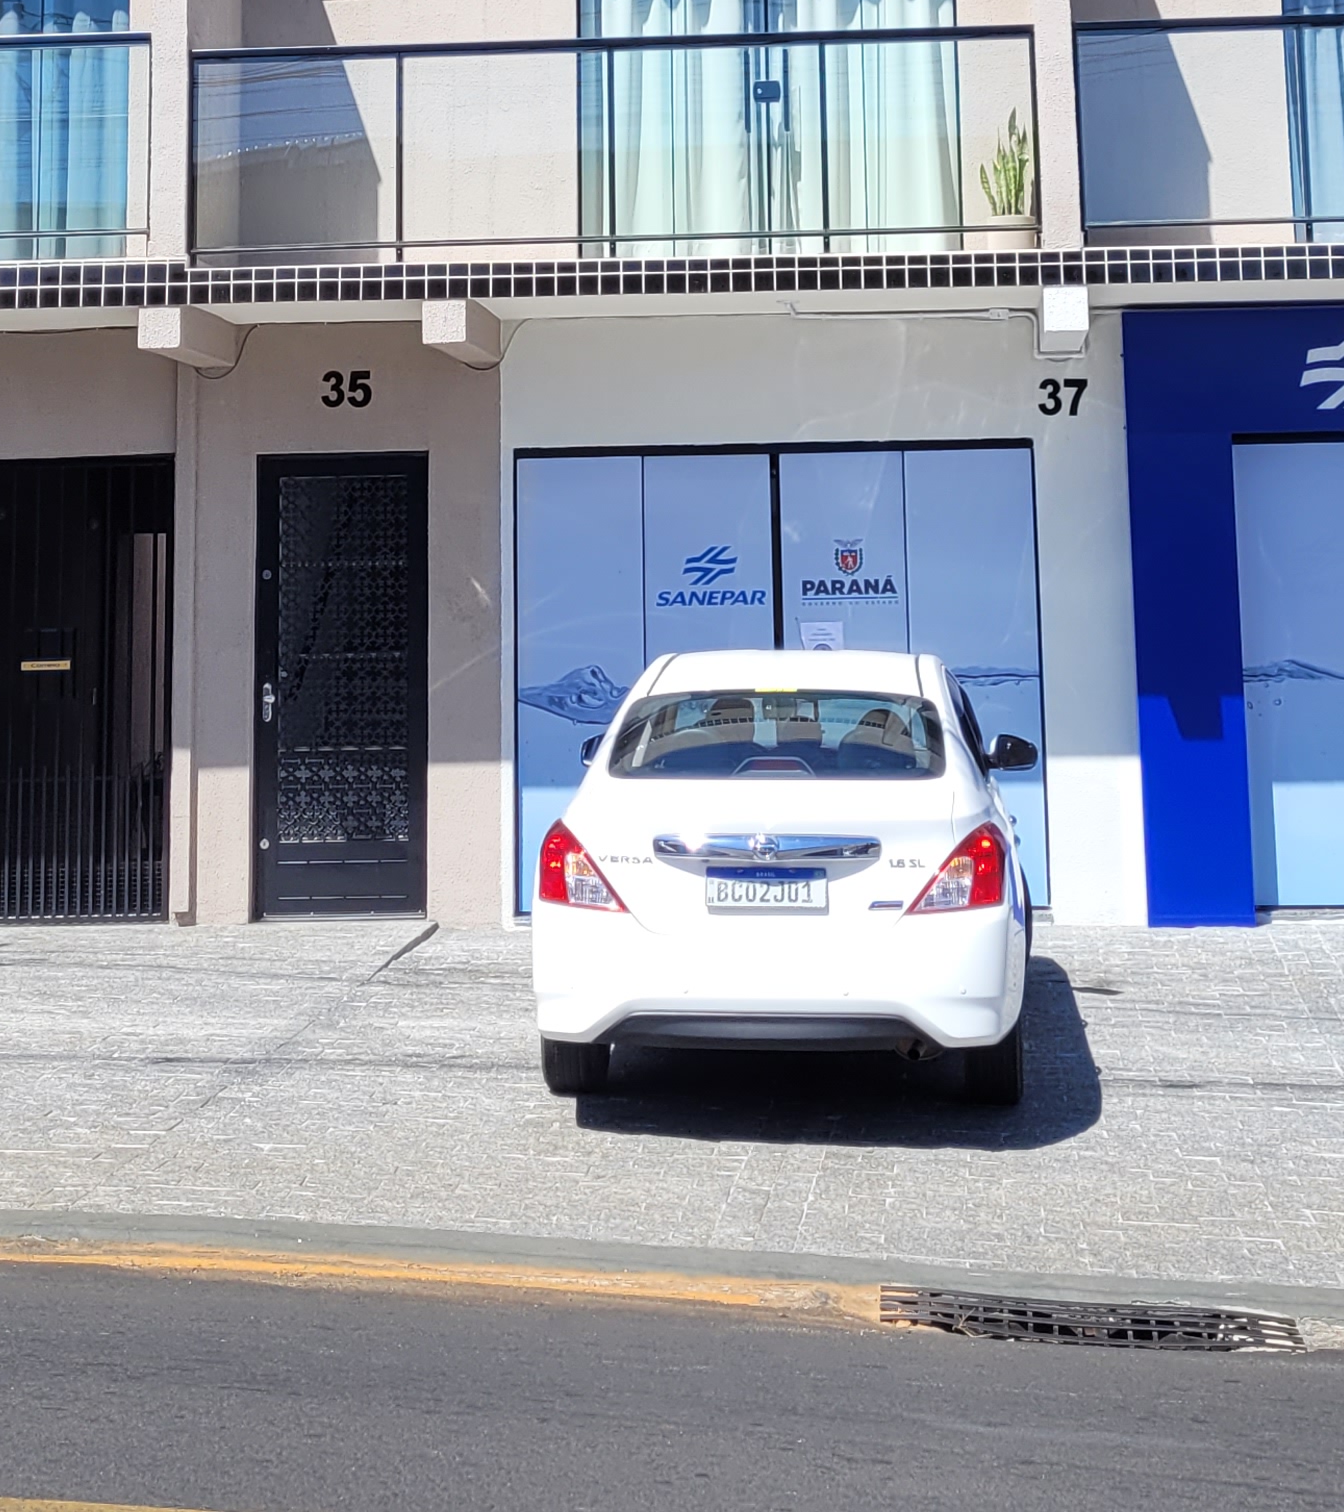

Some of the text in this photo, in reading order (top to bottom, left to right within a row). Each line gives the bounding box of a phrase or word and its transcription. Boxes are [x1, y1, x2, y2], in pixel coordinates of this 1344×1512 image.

[321, 370, 372, 408] 35
[1038, 378, 1088, 416] 37
[801, 575, 898, 597] PARANÁ
[655, 589, 767, 607] SANEPAR
[599, 854, 654, 865] VERSA
[908, 858, 926, 868] SL
